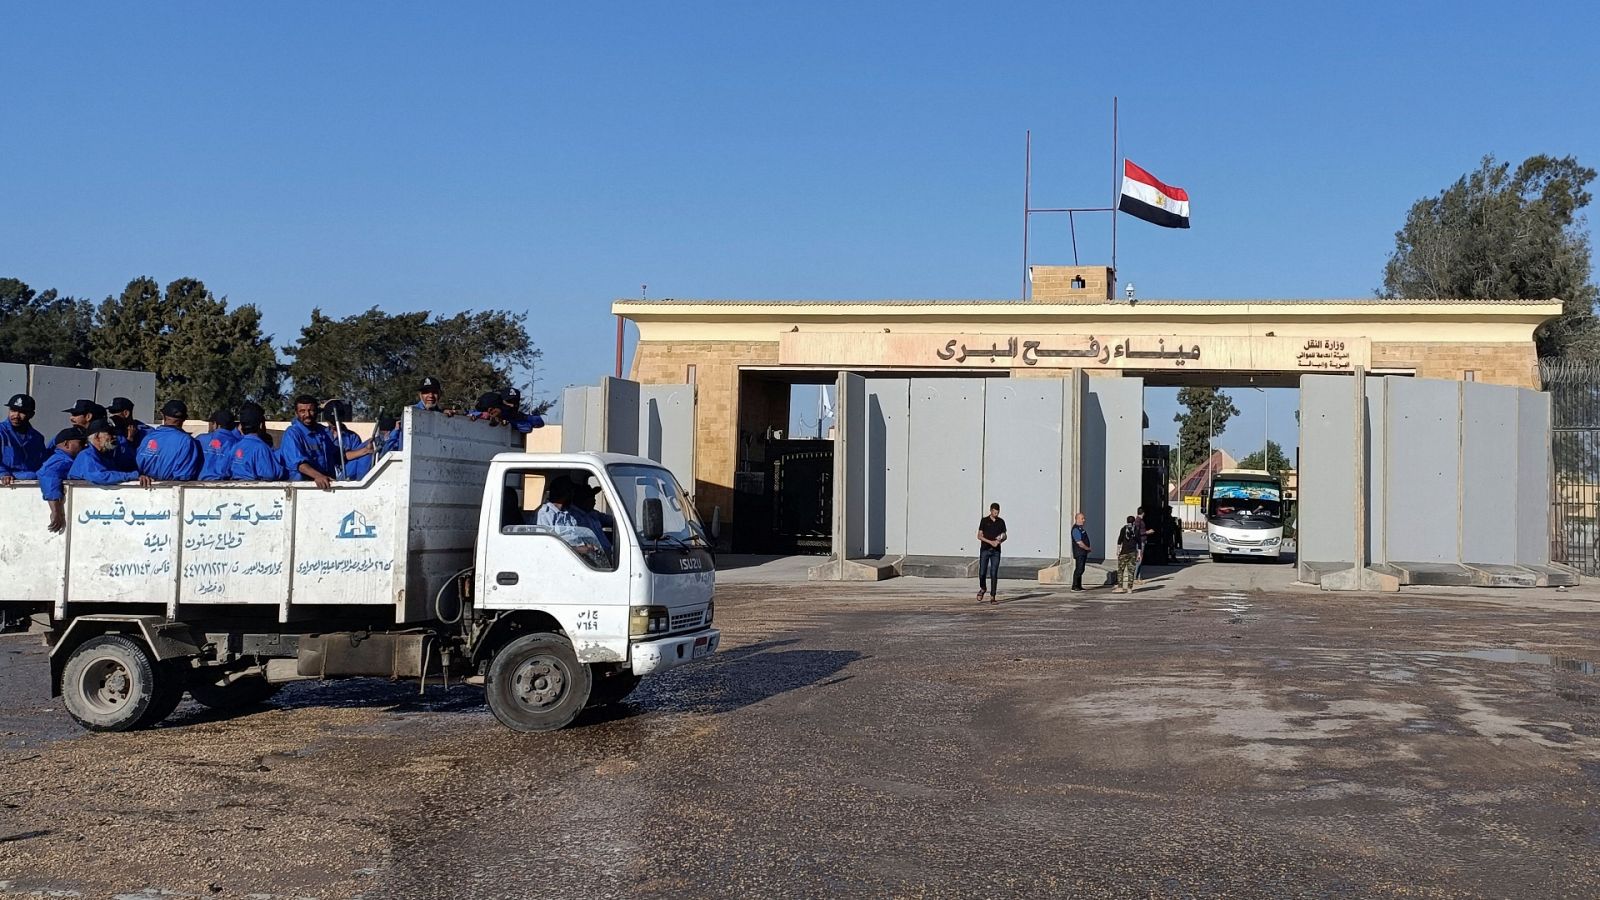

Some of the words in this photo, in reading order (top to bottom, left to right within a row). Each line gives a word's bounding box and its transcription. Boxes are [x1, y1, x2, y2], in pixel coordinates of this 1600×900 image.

[1022, 334, 1110, 365] رفح
[1114, 338, 1201, 366] ميناء
[1303, 340, 1322, 350] النقل
[1325, 340, 1345, 351] وزارة
[184, 502, 228, 527] كير
[230, 497, 284, 526] شركة
[215, 532, 246, 551] قطاع
[680, 558, 702, 570] ISUZU
[576, 621, 599, 631] ٧٦٤٩
